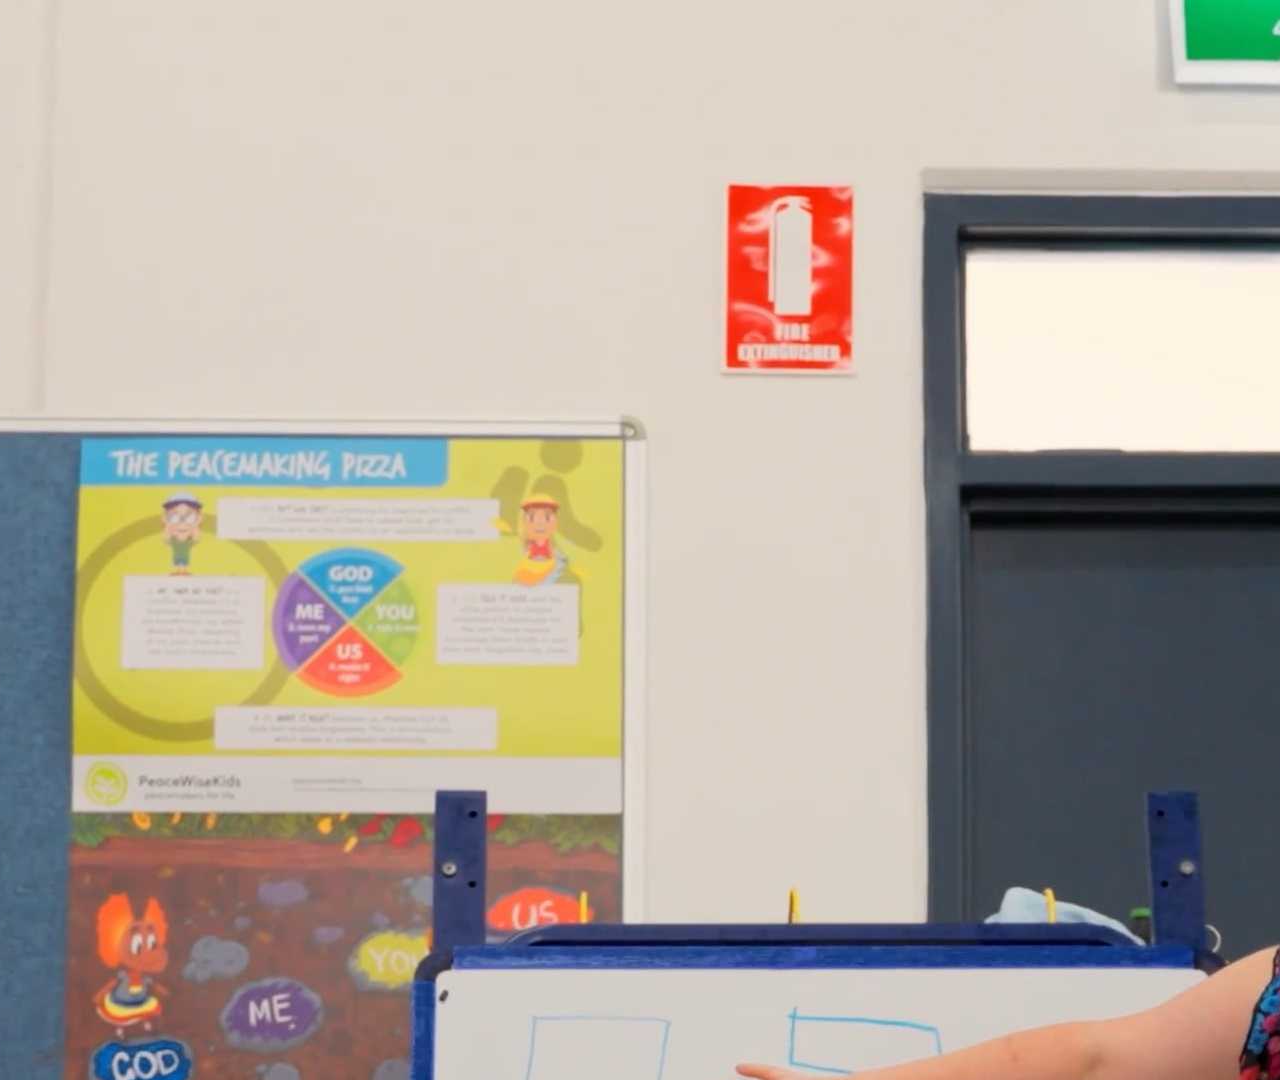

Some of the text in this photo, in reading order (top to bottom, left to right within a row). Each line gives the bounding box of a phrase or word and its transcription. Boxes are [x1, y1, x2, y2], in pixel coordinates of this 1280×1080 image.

[110, 450, 407, 480] THE PEACEMAKING PIZZA
[328, 565, 373, 581] GOD
[295, 604, 325, 620] ME
[376, 604, 415, 620] YOU
[336, 643, 363, 660] US
[139, 775, 241, 788] PeaceWiseKids
[511, 899, 558, 931] US
[248, 993, 291, 1025] ME
